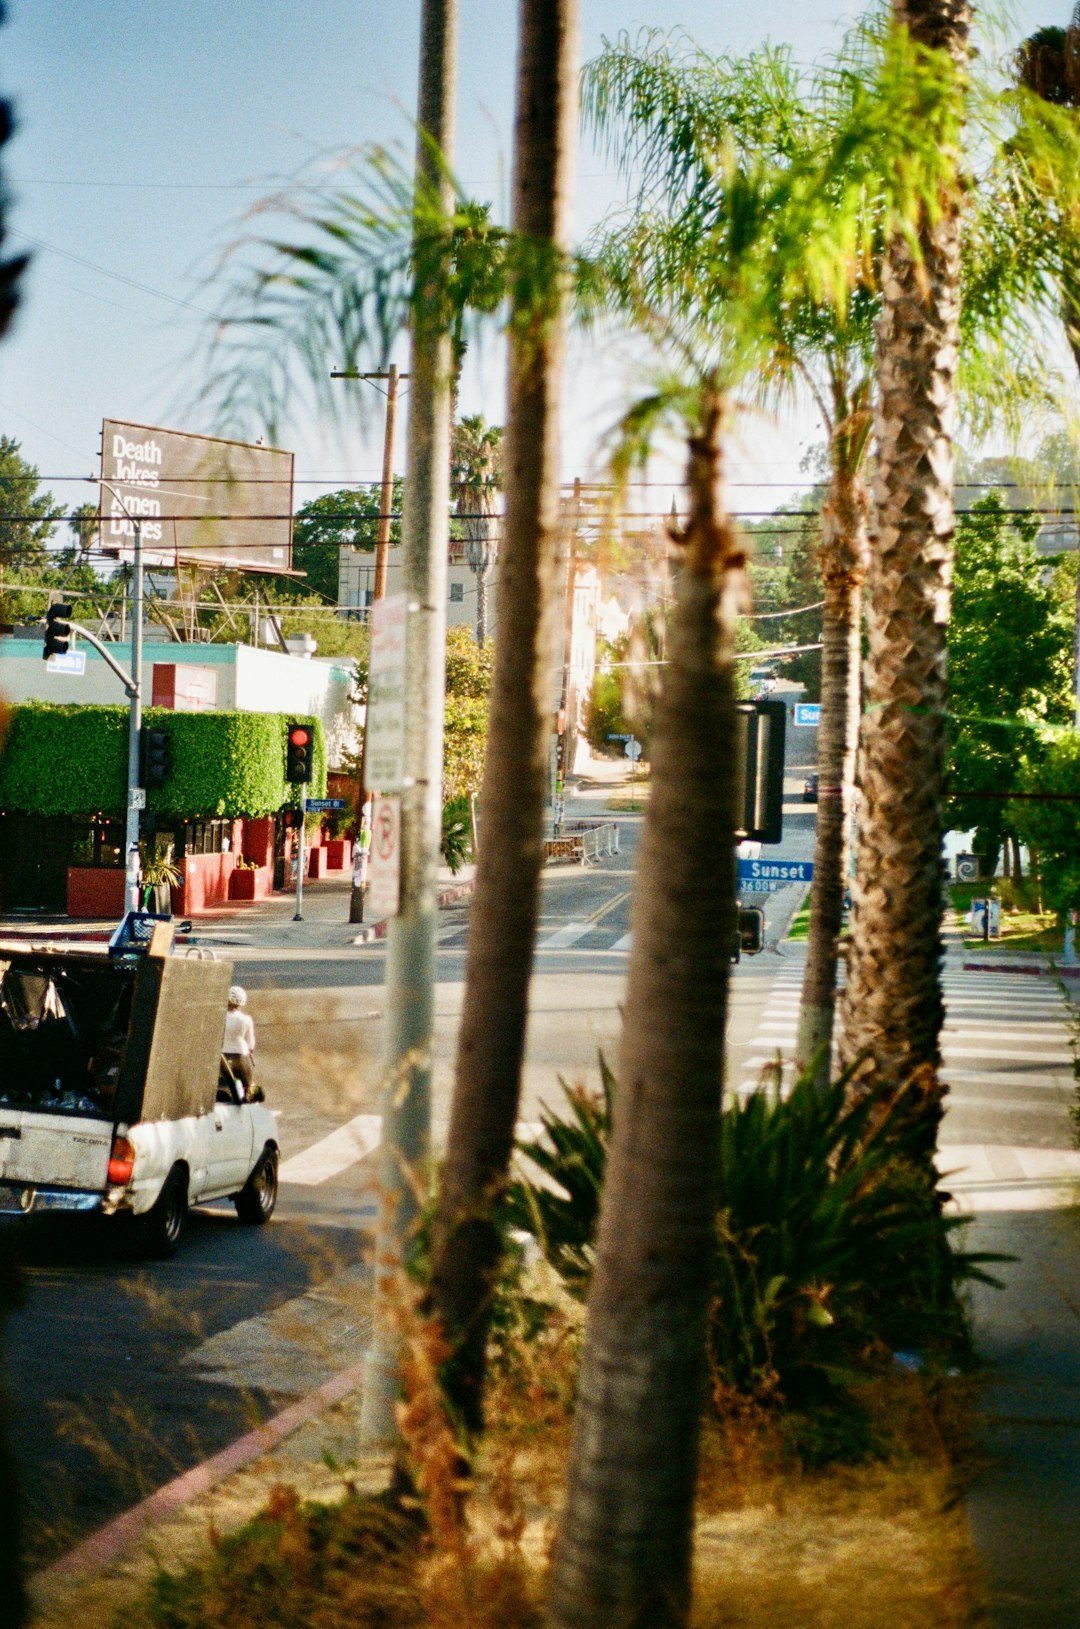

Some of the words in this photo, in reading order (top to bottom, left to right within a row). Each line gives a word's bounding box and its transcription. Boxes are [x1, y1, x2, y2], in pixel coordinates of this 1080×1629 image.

[112, 434, 162, 465] Death
[111, 458, 160, 488] Jokes
[110, 488, 161, 517] Amen
[751, 862, 804, 879] Sunset
[72, 1136, 109, 1146] TACOMA
